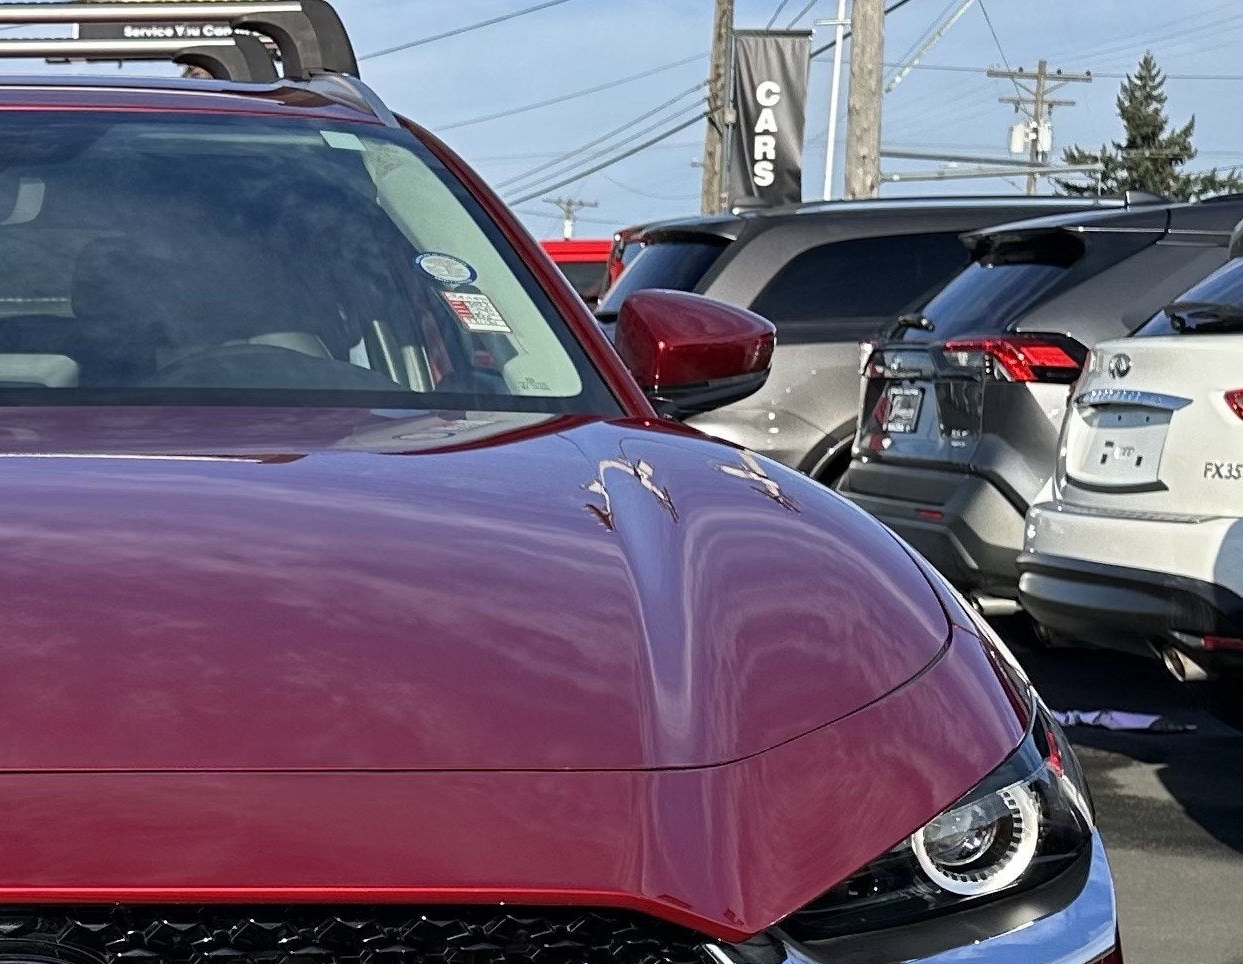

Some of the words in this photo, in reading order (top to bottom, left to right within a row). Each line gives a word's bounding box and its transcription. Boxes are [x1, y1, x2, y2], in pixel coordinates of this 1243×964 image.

[123, 25, 174, 37] Service
[753, 80, 781, 187] CARS
[1203, 461, 1243, 480] FX35
